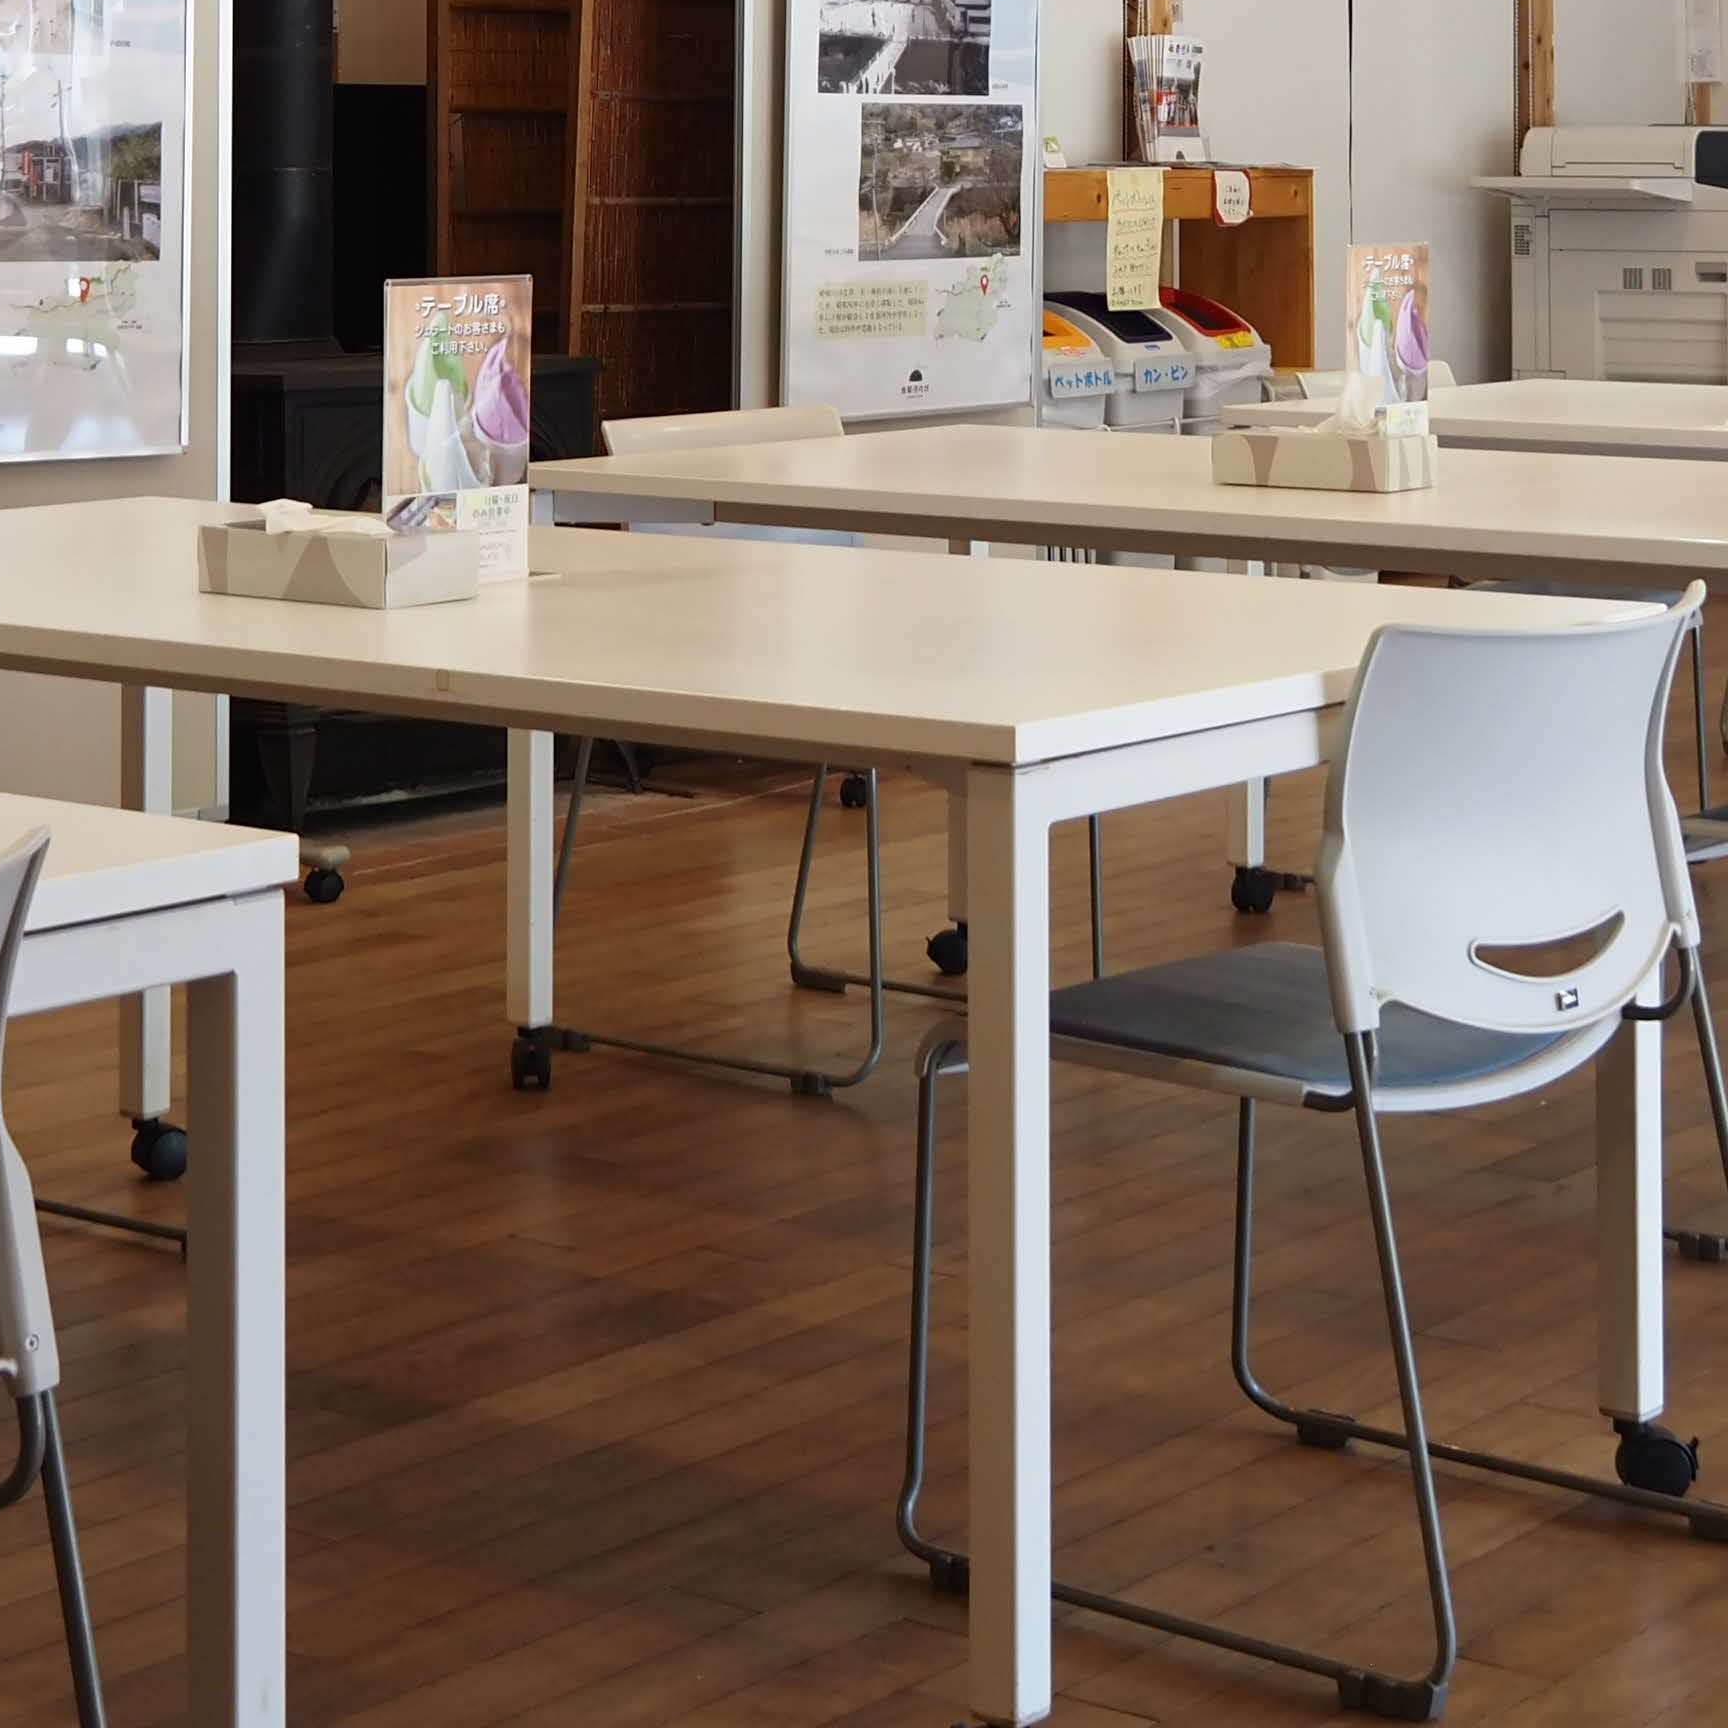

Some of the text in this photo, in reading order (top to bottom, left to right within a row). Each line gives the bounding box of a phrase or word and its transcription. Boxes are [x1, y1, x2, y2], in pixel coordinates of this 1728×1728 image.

[421, 294, 500, 317] テーブル席
[1055, 372, 1112, 389] ペットボトル
